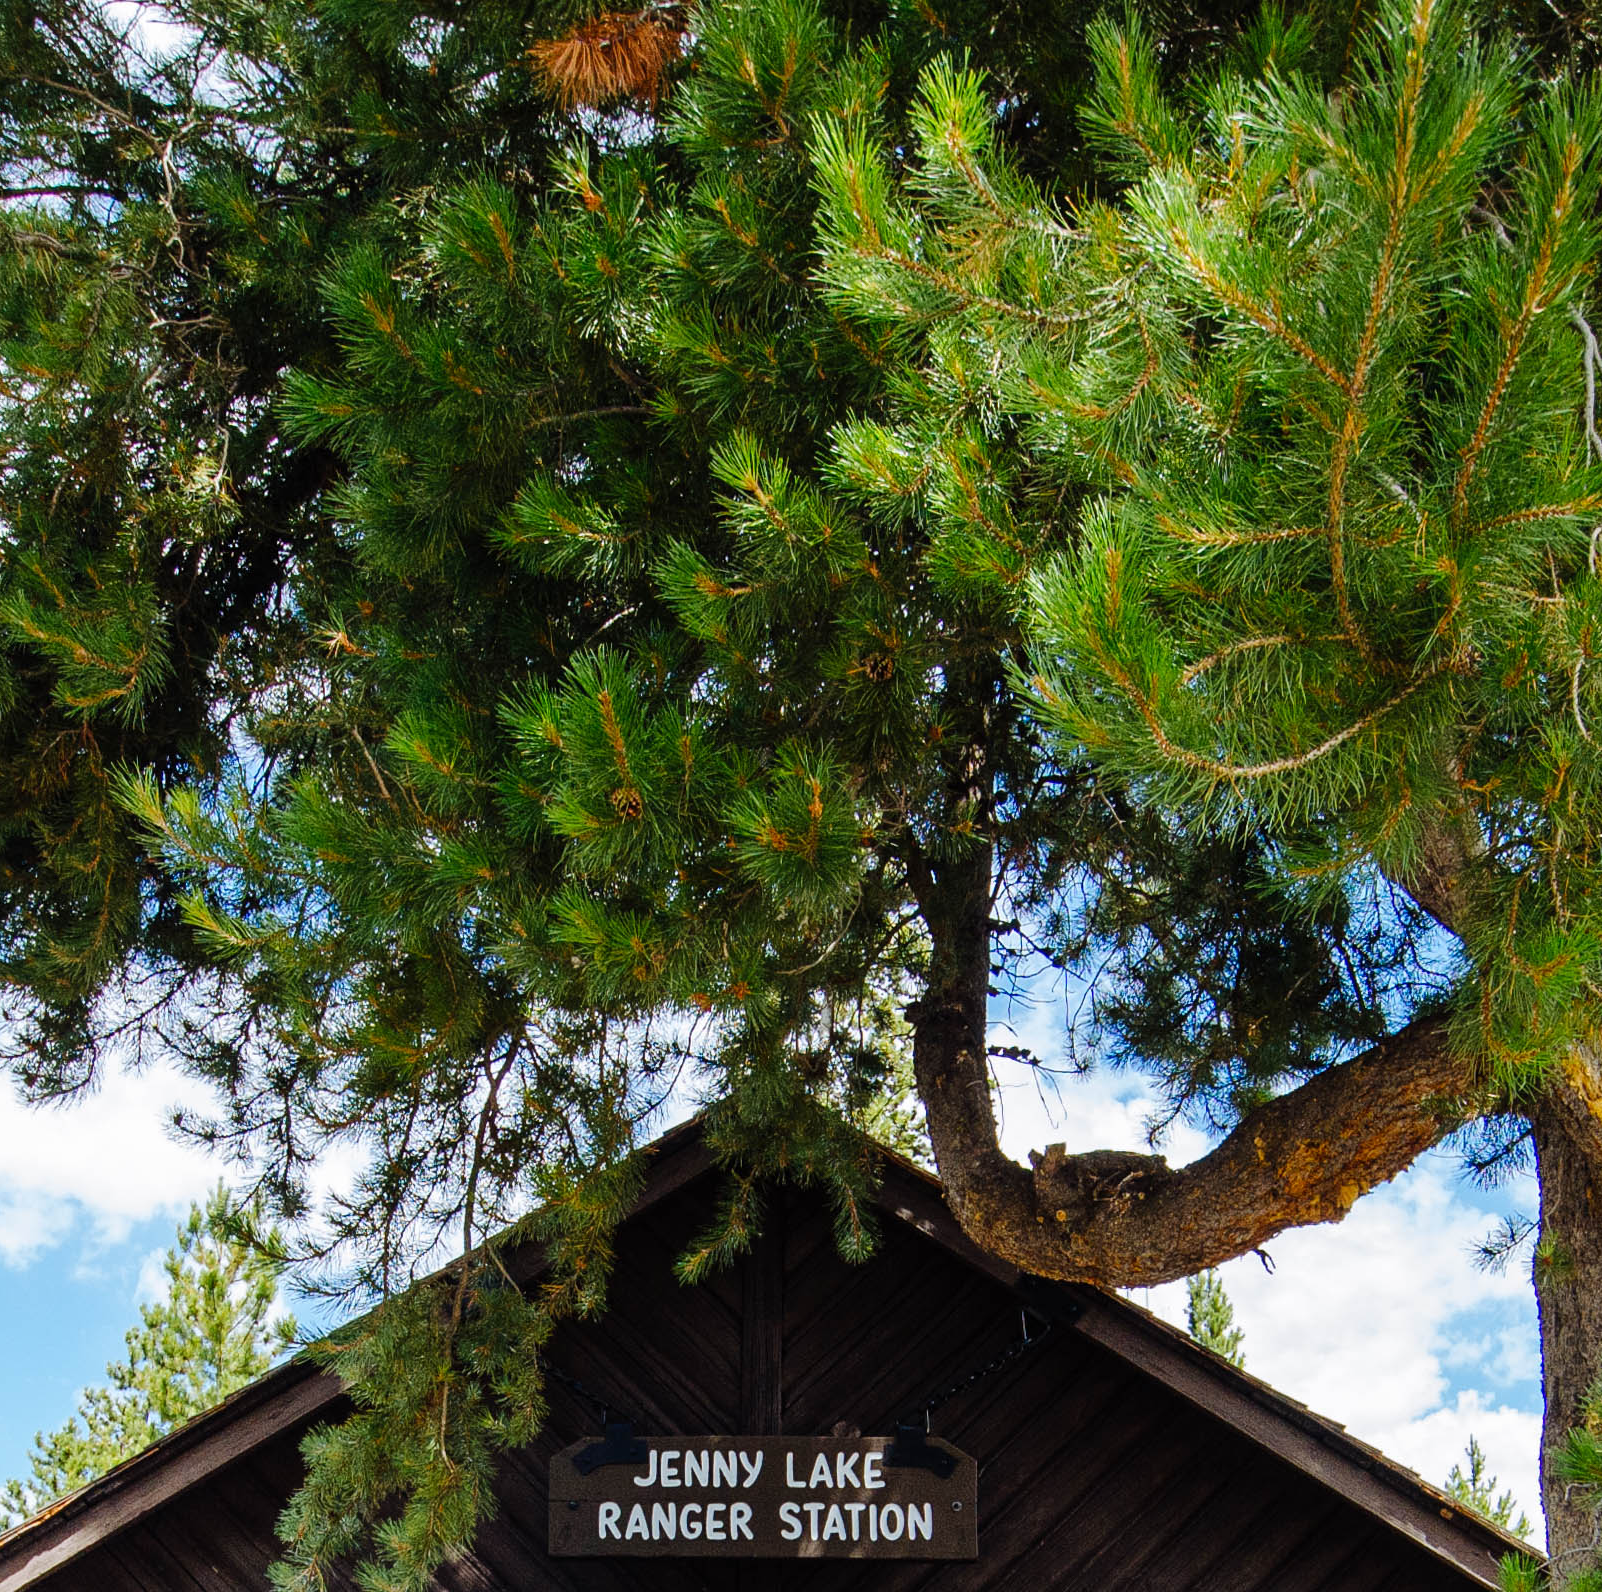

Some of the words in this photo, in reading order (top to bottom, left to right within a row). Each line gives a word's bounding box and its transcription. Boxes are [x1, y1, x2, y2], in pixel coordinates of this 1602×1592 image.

[633, 1449, 764, 1488] JENNY
[786, 1451, 886, 1489] LAKE
[598, 1501, 754, 1541] RANGER
[779, 1501, 933, 1542] STATION
